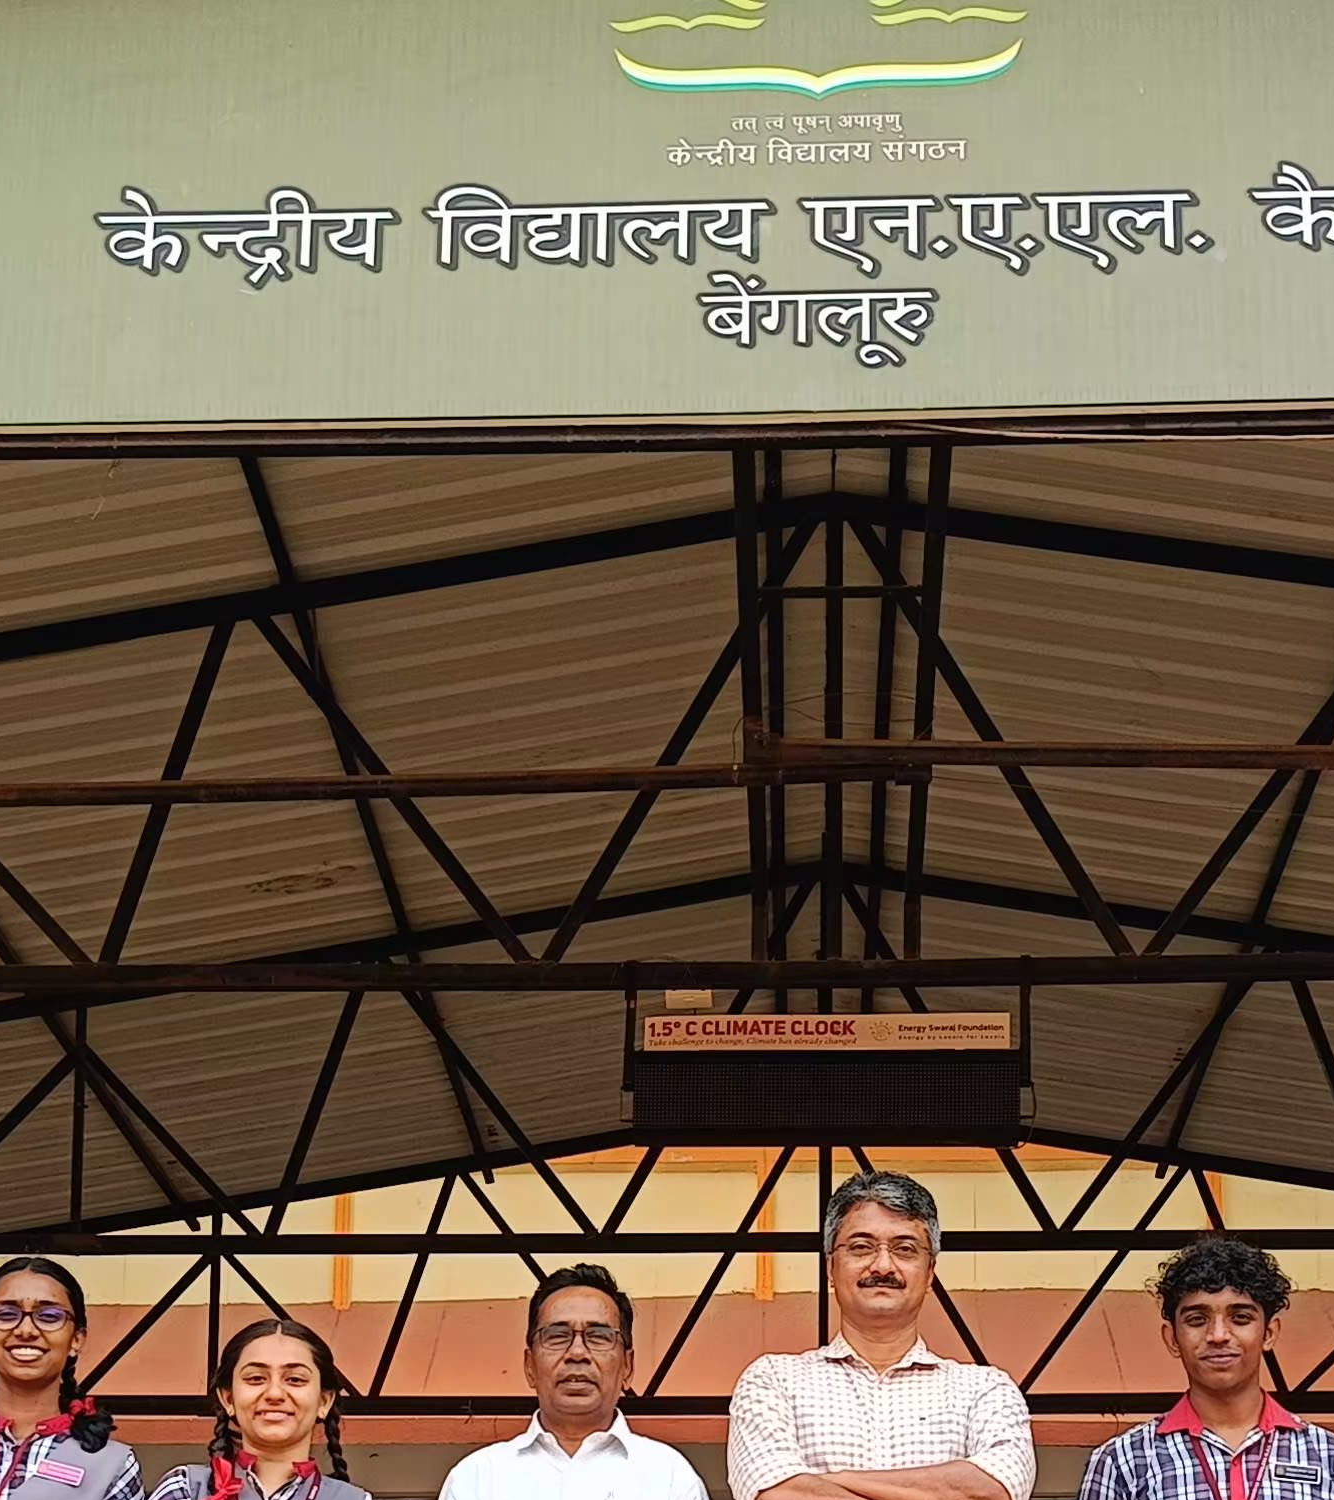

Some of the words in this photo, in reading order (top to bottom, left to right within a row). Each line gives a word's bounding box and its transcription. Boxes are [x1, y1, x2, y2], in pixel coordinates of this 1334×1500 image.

[667, 138, 758, 166] केन्द्रीय
[766, 136, 872, 164] विद्यालय
[881, 132, 968, 161] संगठन
[95, 187, 399, 287] केन्द्रीय
[433, 184, 775, 272] विद्यालय
[798, 190, 1214, 277] एन.ए.एल.
[697, 271, 940, 367] बेंगलूरु
[648, 1021, 681, 1037] 1.5°
[685, 1020, 698, 1036] C
[702, 1020, 786, 1036] CLIMATE
[791, 1020, 856, 1036] CLOCK
[898, 1024, 926, 1032] Energy
[928, 1024, 956, 1032] Swaraj
[649, 1038, 667, 1047] Take
[668, 1037, 705, 1047] challenge
[705, 1038, 714, 1046] to
[746, 1037, 777, 1045] Climate
[778, 1037, 793, 1045] has
[794, 1037, 823, 1046] already
[823, 1037, 857, 1046] changed
